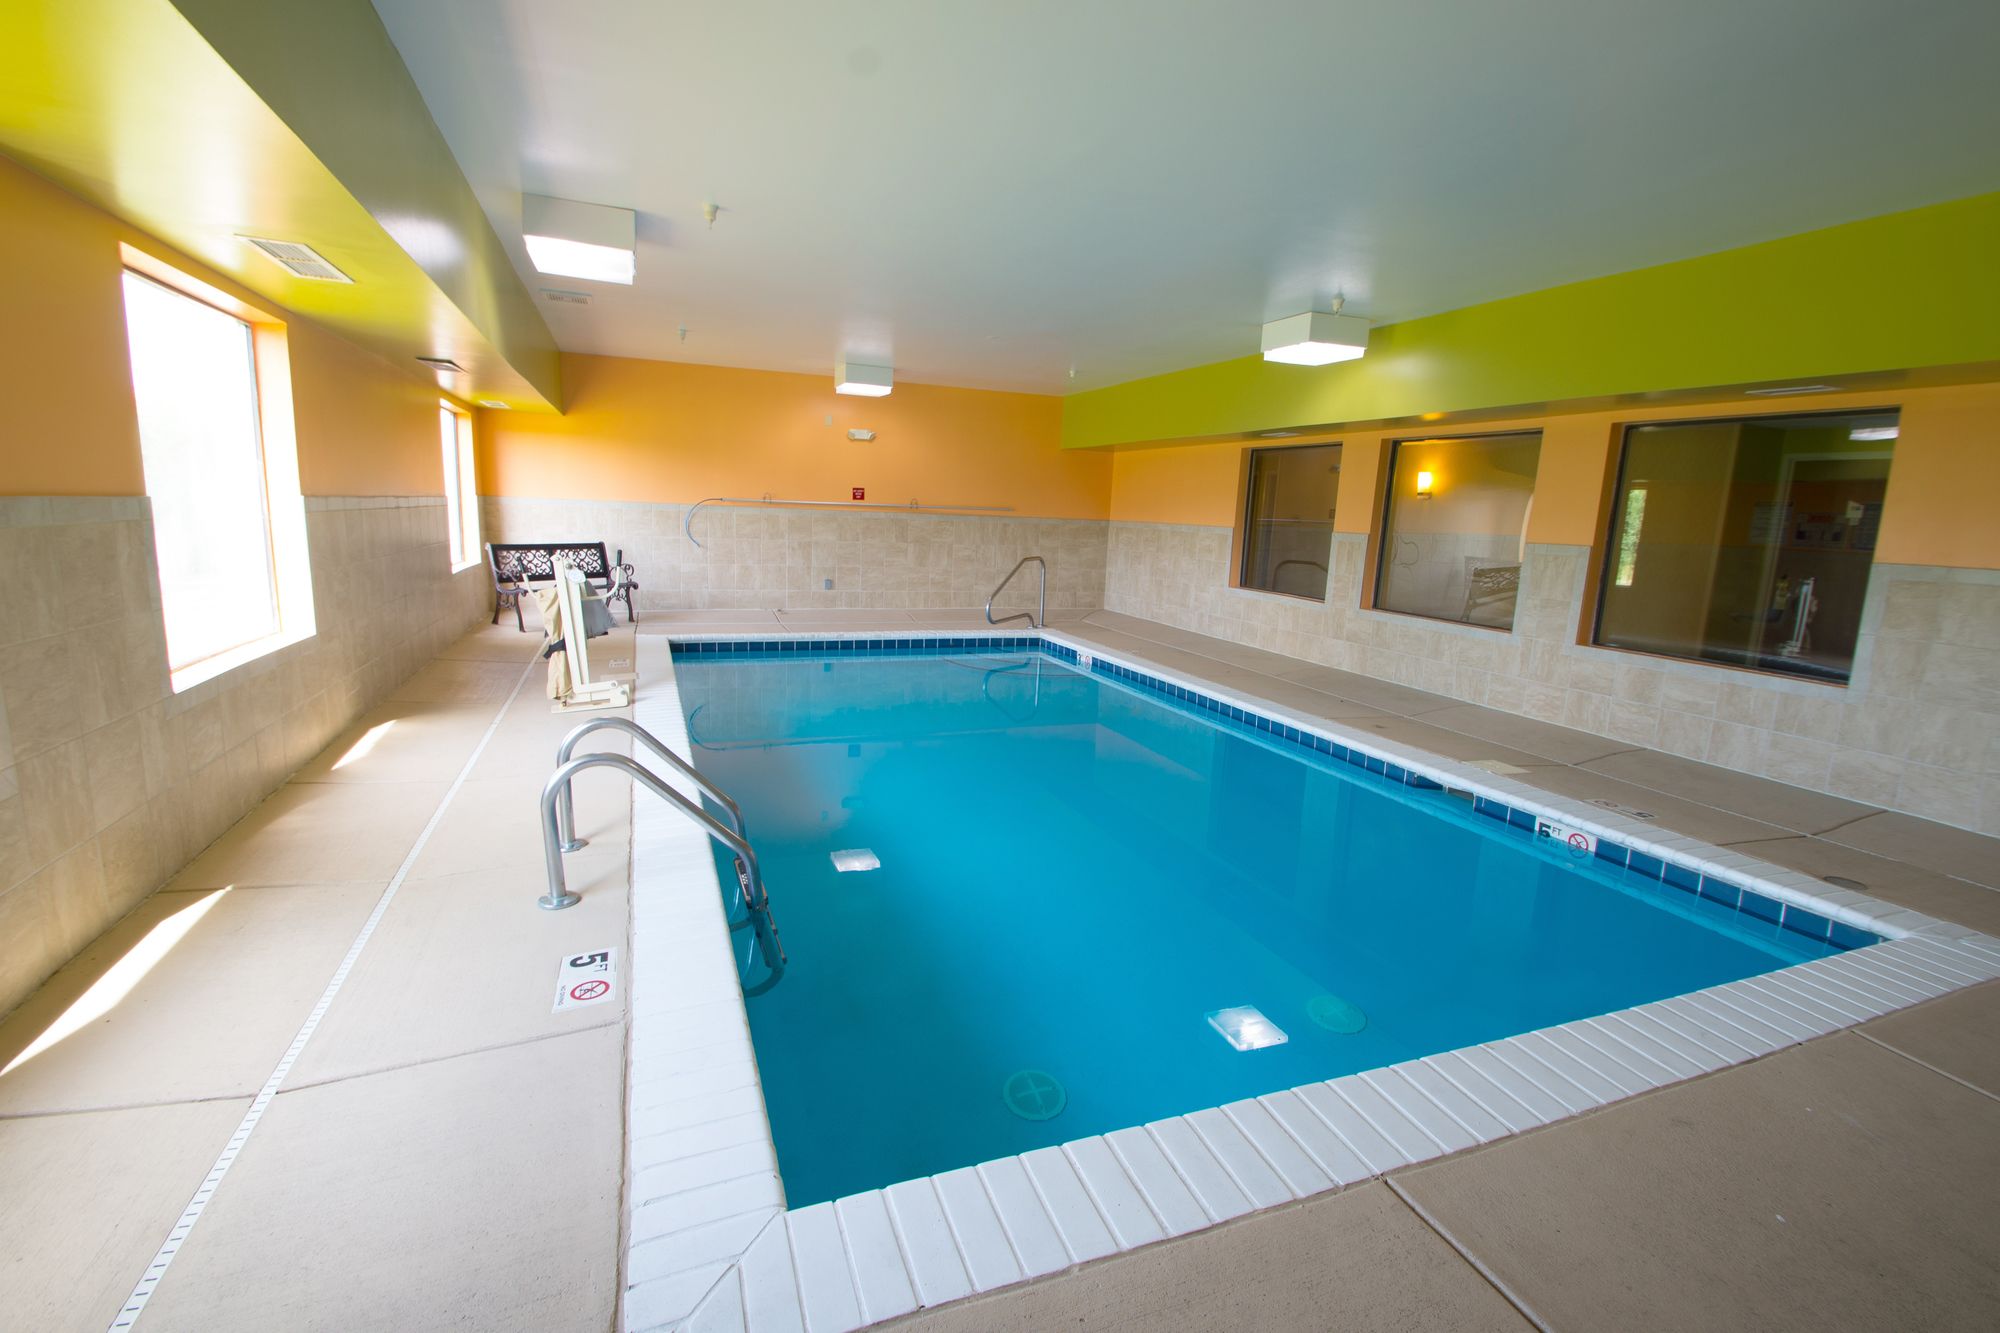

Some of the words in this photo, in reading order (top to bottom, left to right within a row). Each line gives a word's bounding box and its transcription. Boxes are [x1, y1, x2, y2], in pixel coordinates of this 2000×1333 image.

[1538, 821, 1551, 838] 5
[1552, 826, 1562, 836] FT
[570, 952, 609, 968] 5
[593, 963, 608, 972] FT
